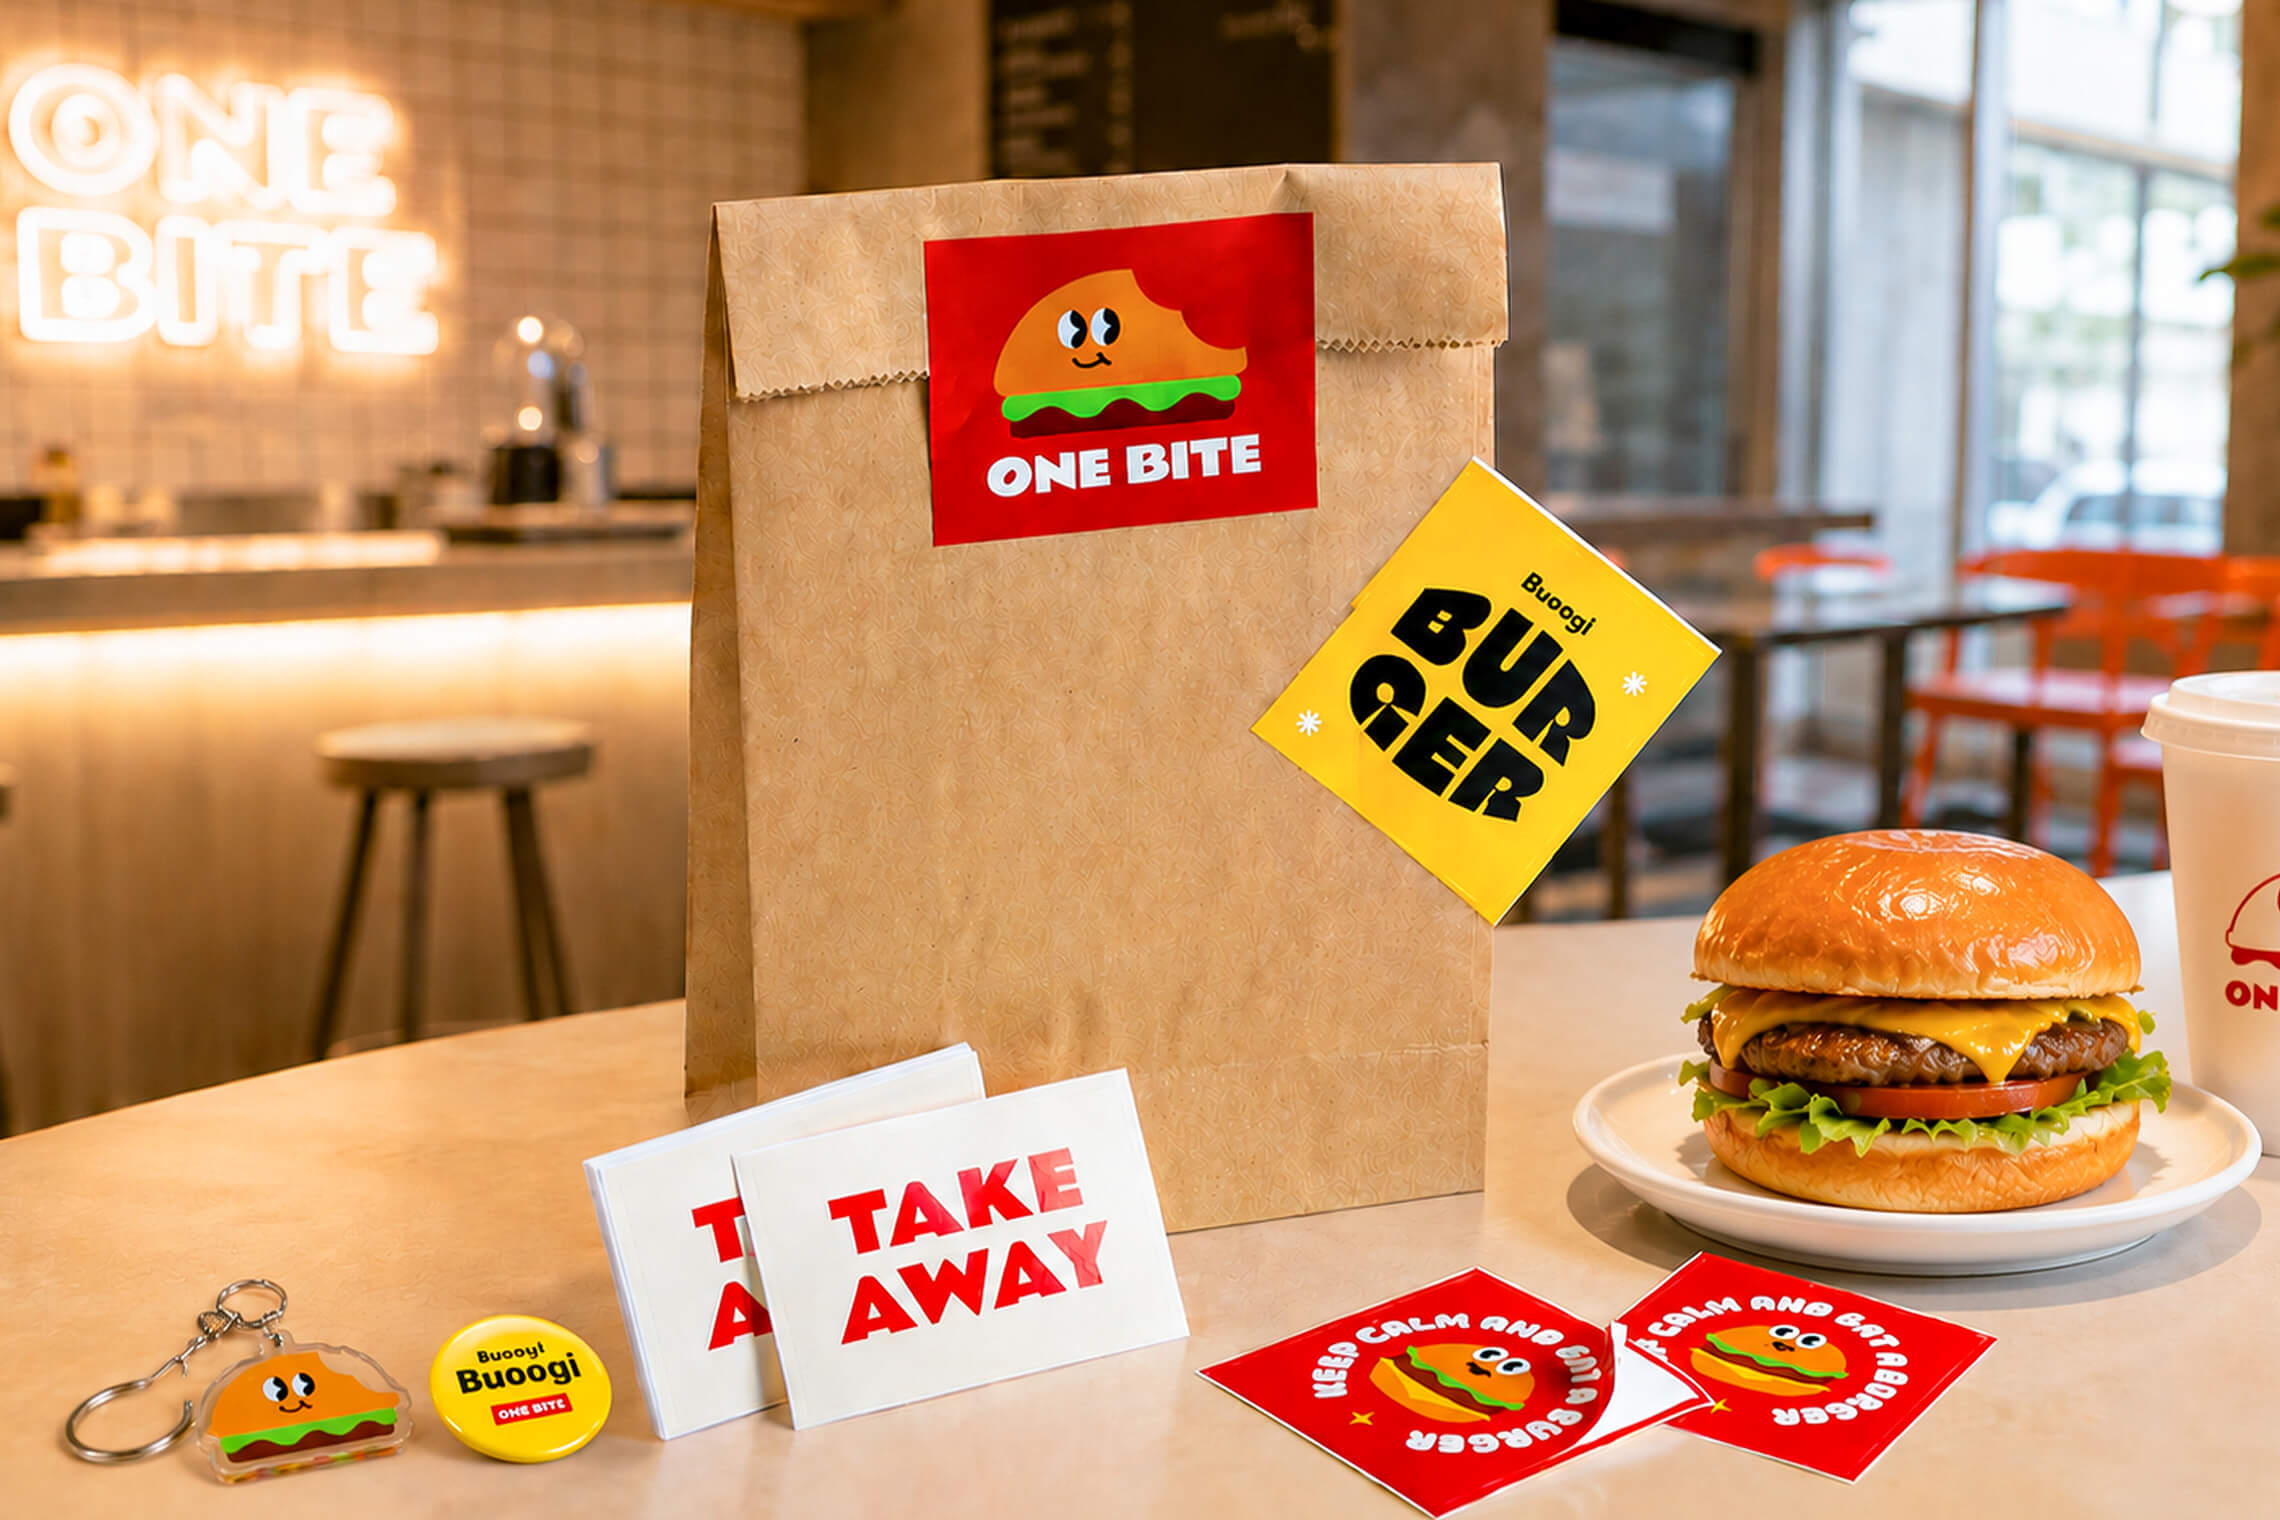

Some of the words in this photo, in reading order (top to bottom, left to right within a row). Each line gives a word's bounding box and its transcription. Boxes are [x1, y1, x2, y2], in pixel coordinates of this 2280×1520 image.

[8, 63, 397, 216] ONE
[16, 206, 439, 355] BITE
[987, 448, 1111, 497] ONE
[1126, 433, 1262, 485] BITE
[1521, 572, 1597, 636] Buoogi
[1390, 588, 1596, 767] BUR
[2225, 980, 2278, 1012] ON
[828, 1148, 1084, 1255] TAKE
[841, 1220, 1108, 1345] AWAY
[1750, 1295, 1833, 1317] AND
[456, 1352, 581, 1394] Buoogi
[1312, 1341, 1359, 1399] KEEP
[1355, 1313, 1470, 1344] CALM
[1480, 1316, 1564, 1345] AND
